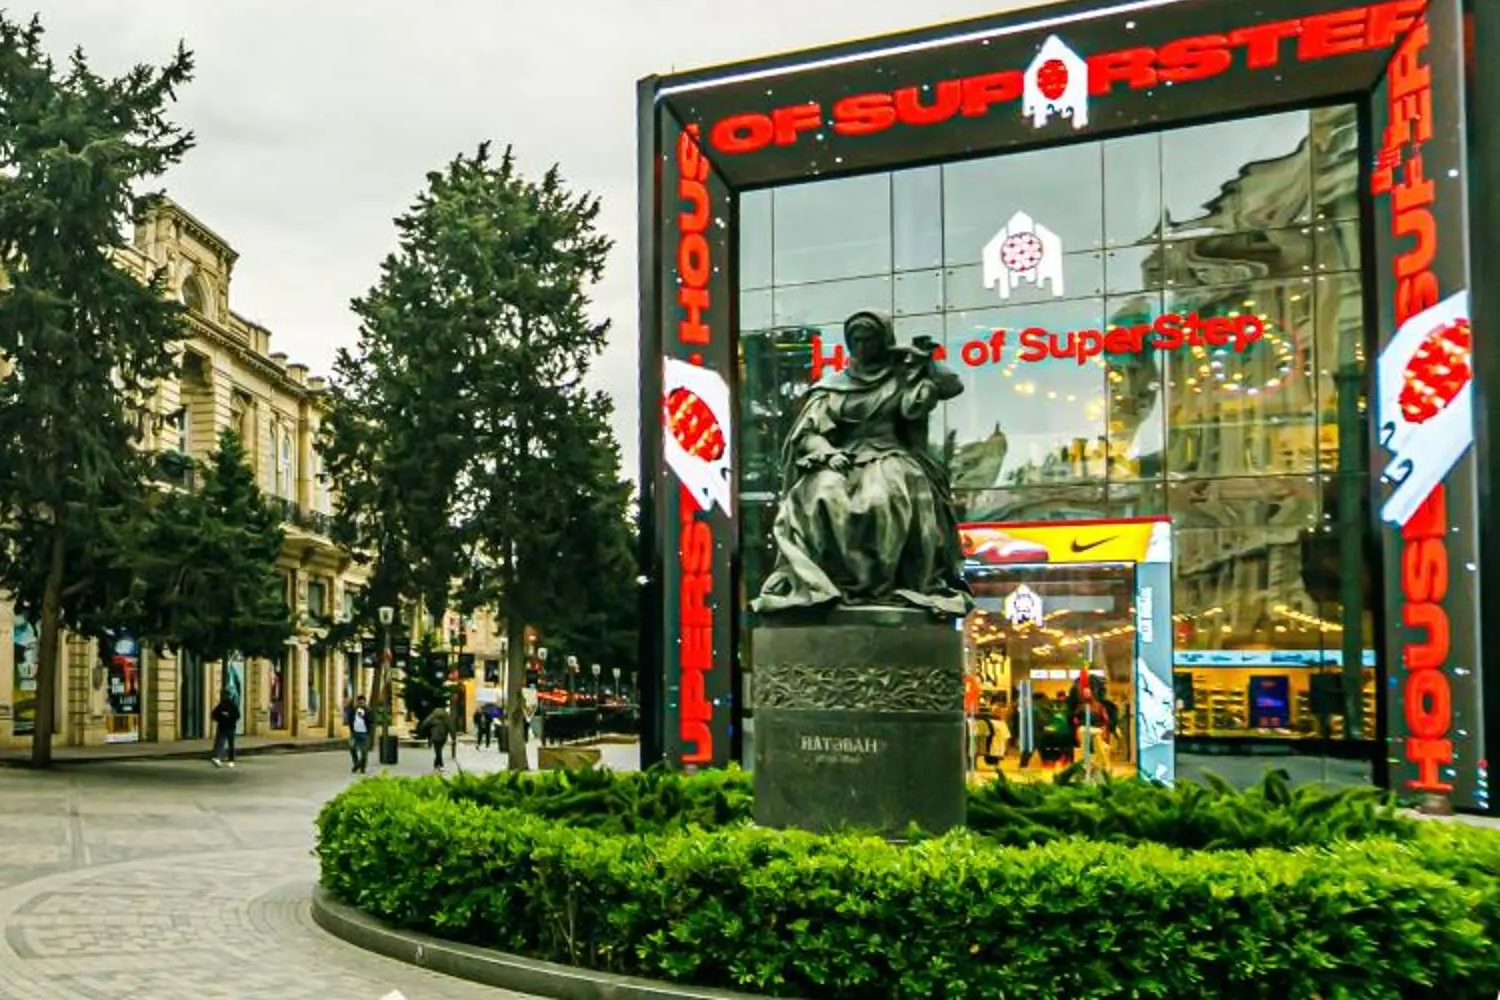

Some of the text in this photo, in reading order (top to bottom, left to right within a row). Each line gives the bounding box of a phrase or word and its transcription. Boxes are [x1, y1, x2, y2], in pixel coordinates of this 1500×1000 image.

[709, 102, 821, 155] OF
[962, 329, 1005, 366] of
[1019, 311, 1263, 366] SuperStep
